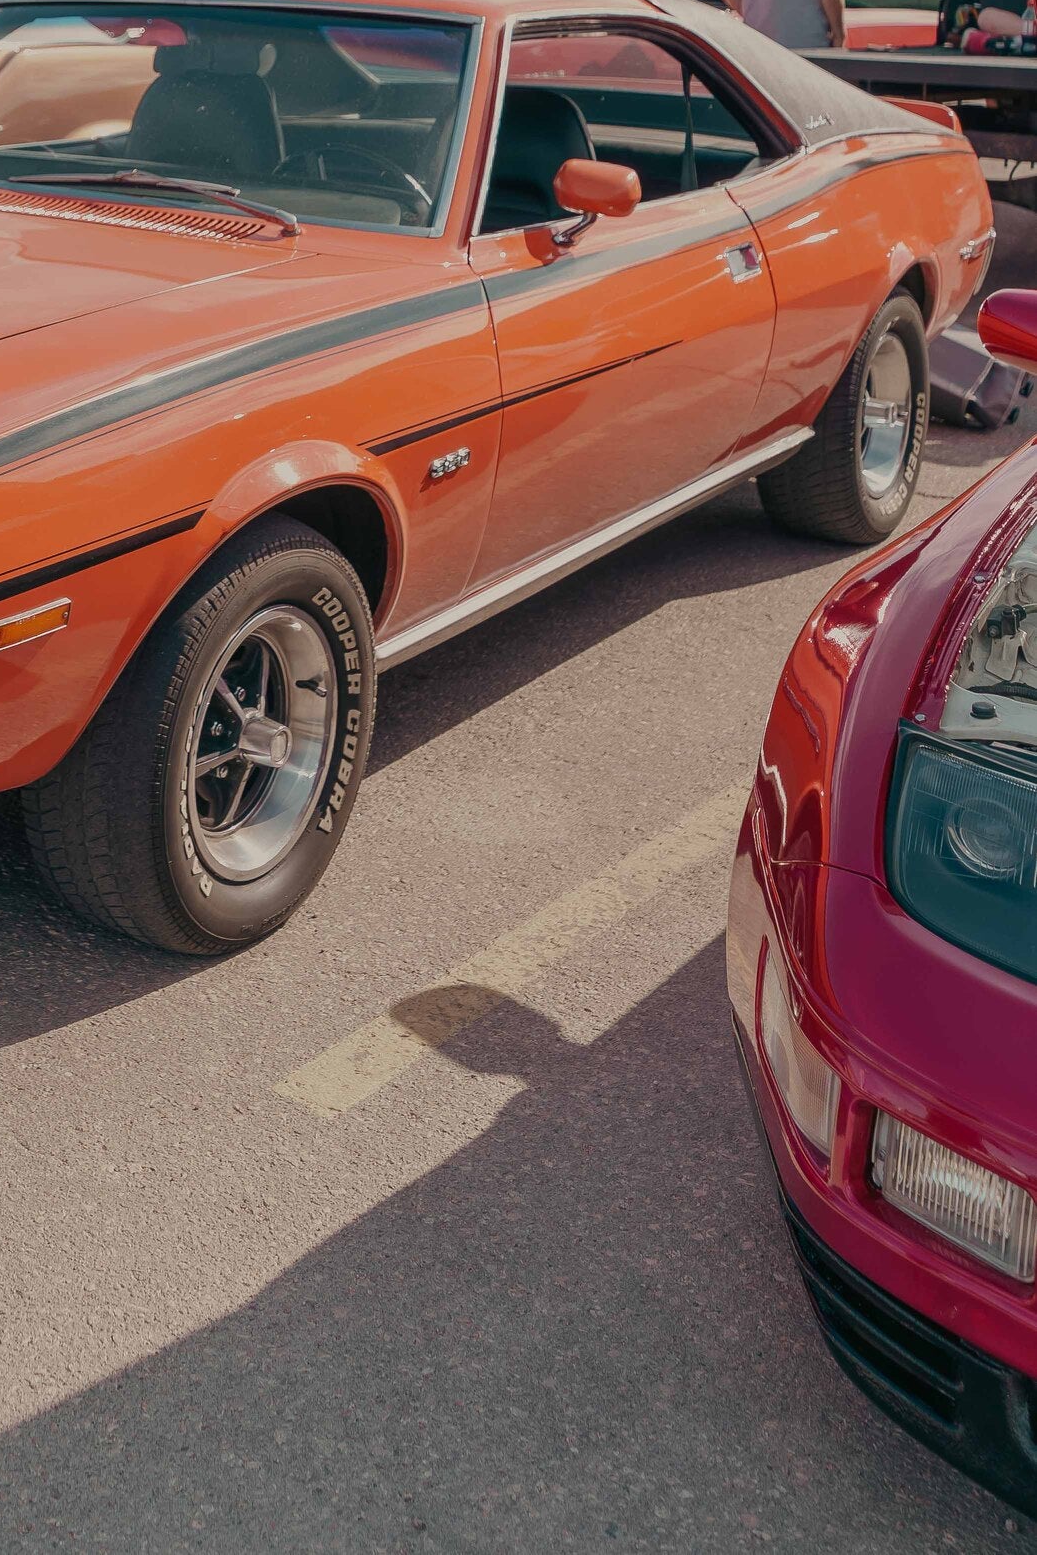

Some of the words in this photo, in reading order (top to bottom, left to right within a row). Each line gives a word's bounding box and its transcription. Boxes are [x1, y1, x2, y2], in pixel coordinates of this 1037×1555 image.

[904, 392, 926, 483] COOPER
[311, 587, 362, 695] COOPER
[318, 708, 362, 833] COBRA
